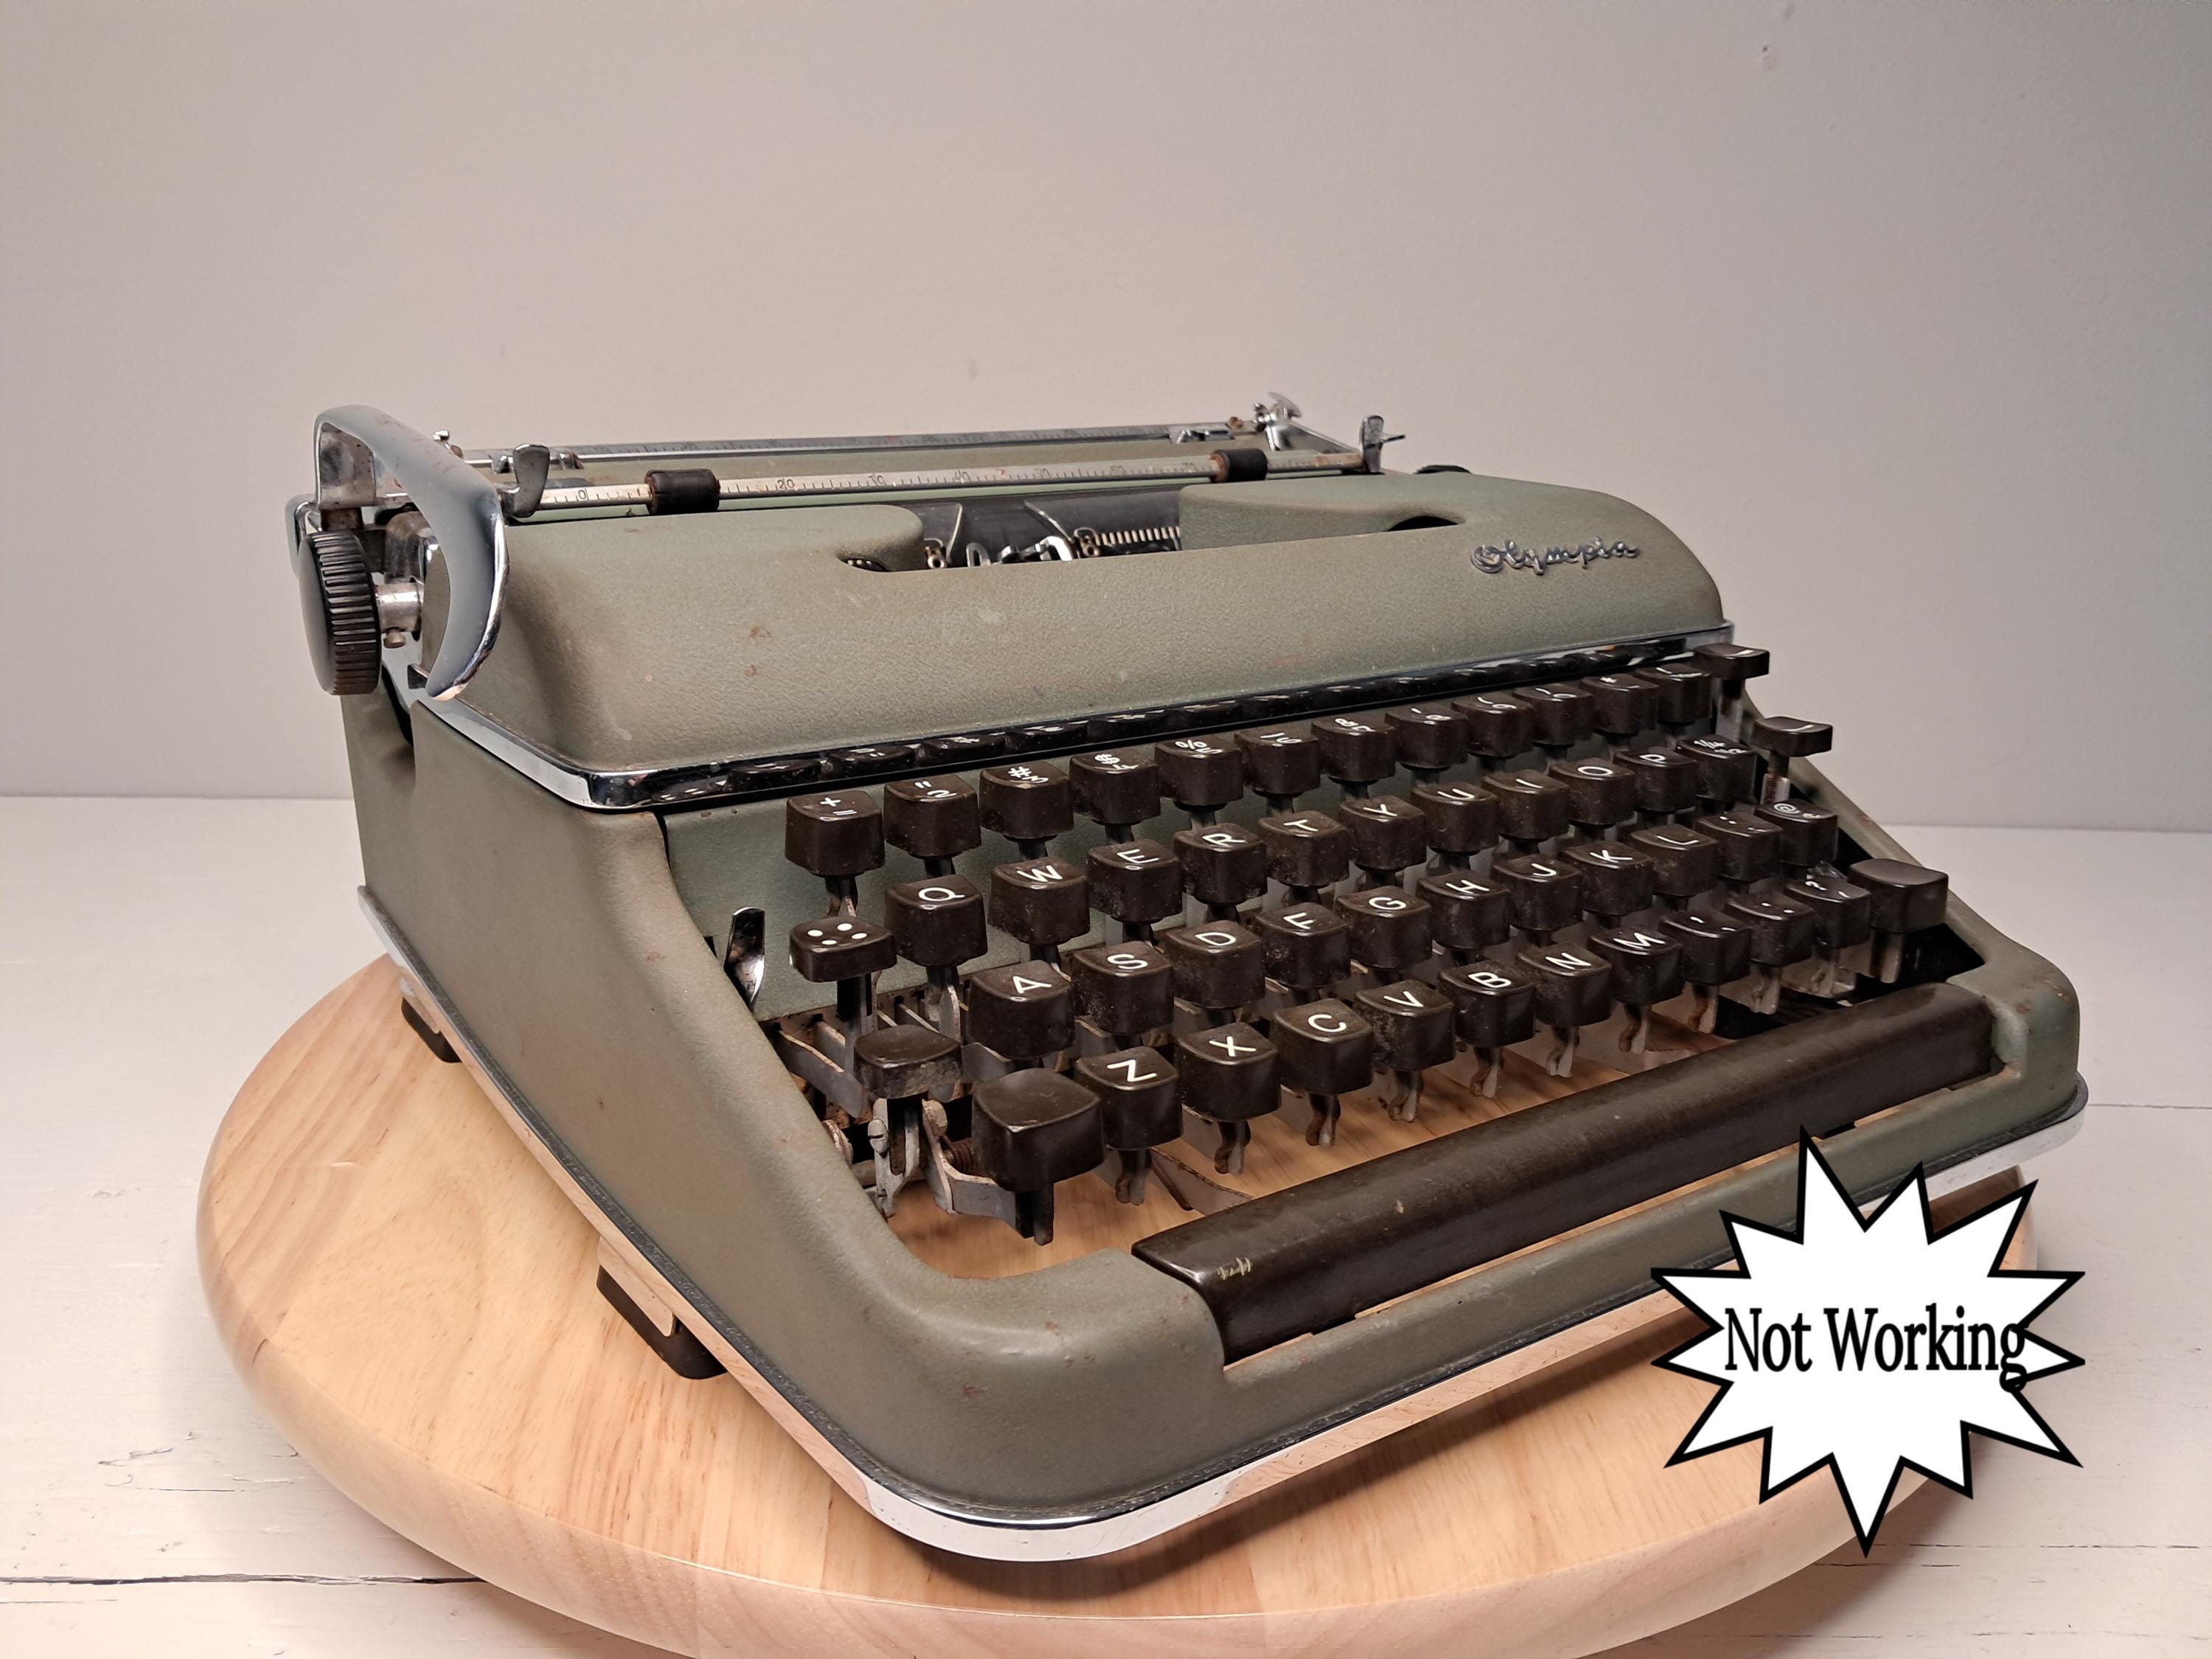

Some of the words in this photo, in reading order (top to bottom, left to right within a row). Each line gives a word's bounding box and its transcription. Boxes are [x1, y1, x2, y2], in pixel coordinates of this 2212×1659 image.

[776, 479, 796, 490] 20
[1471, 539, 1640, 576] Olympia
[1335, 718, 1358, 727] &
[1350, 723, 1375, 732] 7
[1175, 739, 1208, 751] %
[1274, 735, 1302, 745] 6
[1195, 745, 1223, 754] 5
[1094, 754, 1120, 765] $
[1639, 754, 1666, 764] P
[1008, 766, 1033, 779] #
[1577, 766, 1613, 776] O
[914, 781, 932, 789] "
[1020, 773, 1049, 784] 3
[927, 790, 957, 799] 2
[1437, 788, 1475, 803] U
[1363, 804, 1397, 818] Y
[1773, 803, 1801, 814] @
[1283, 819, 1318, 833] T
[1202, 833, 1245, 848] R
[1656, 835, 1698, 845] L
[1116, 849, 1159, 864] E
[1590, 849, 1633, 863] K
[1016, 865, 1062, 884] W
[1531, 863, 1557, 877] J
[1445, 880, 1489, 894] H
[918, 887, 965, 902] Q
[1368, 897, 1407, 910] G
[1283, 912, 1314, 930] F
[1194, 932, 1237, 947] D
[1613, 932, 1666, 948] M
[1107, 953, 1148, 970] S
[1545, 953, 1591, 970] N
[1012, 975, 1052, 994] A
[1468, 972, 1512, 988] B
[1383, 991, 1424, 1007] V
[1307, 1014, 1347, 1032] C
[1208, 1036, 1256, 1057] X
[1107, 1059, 1157, 1082] Z
